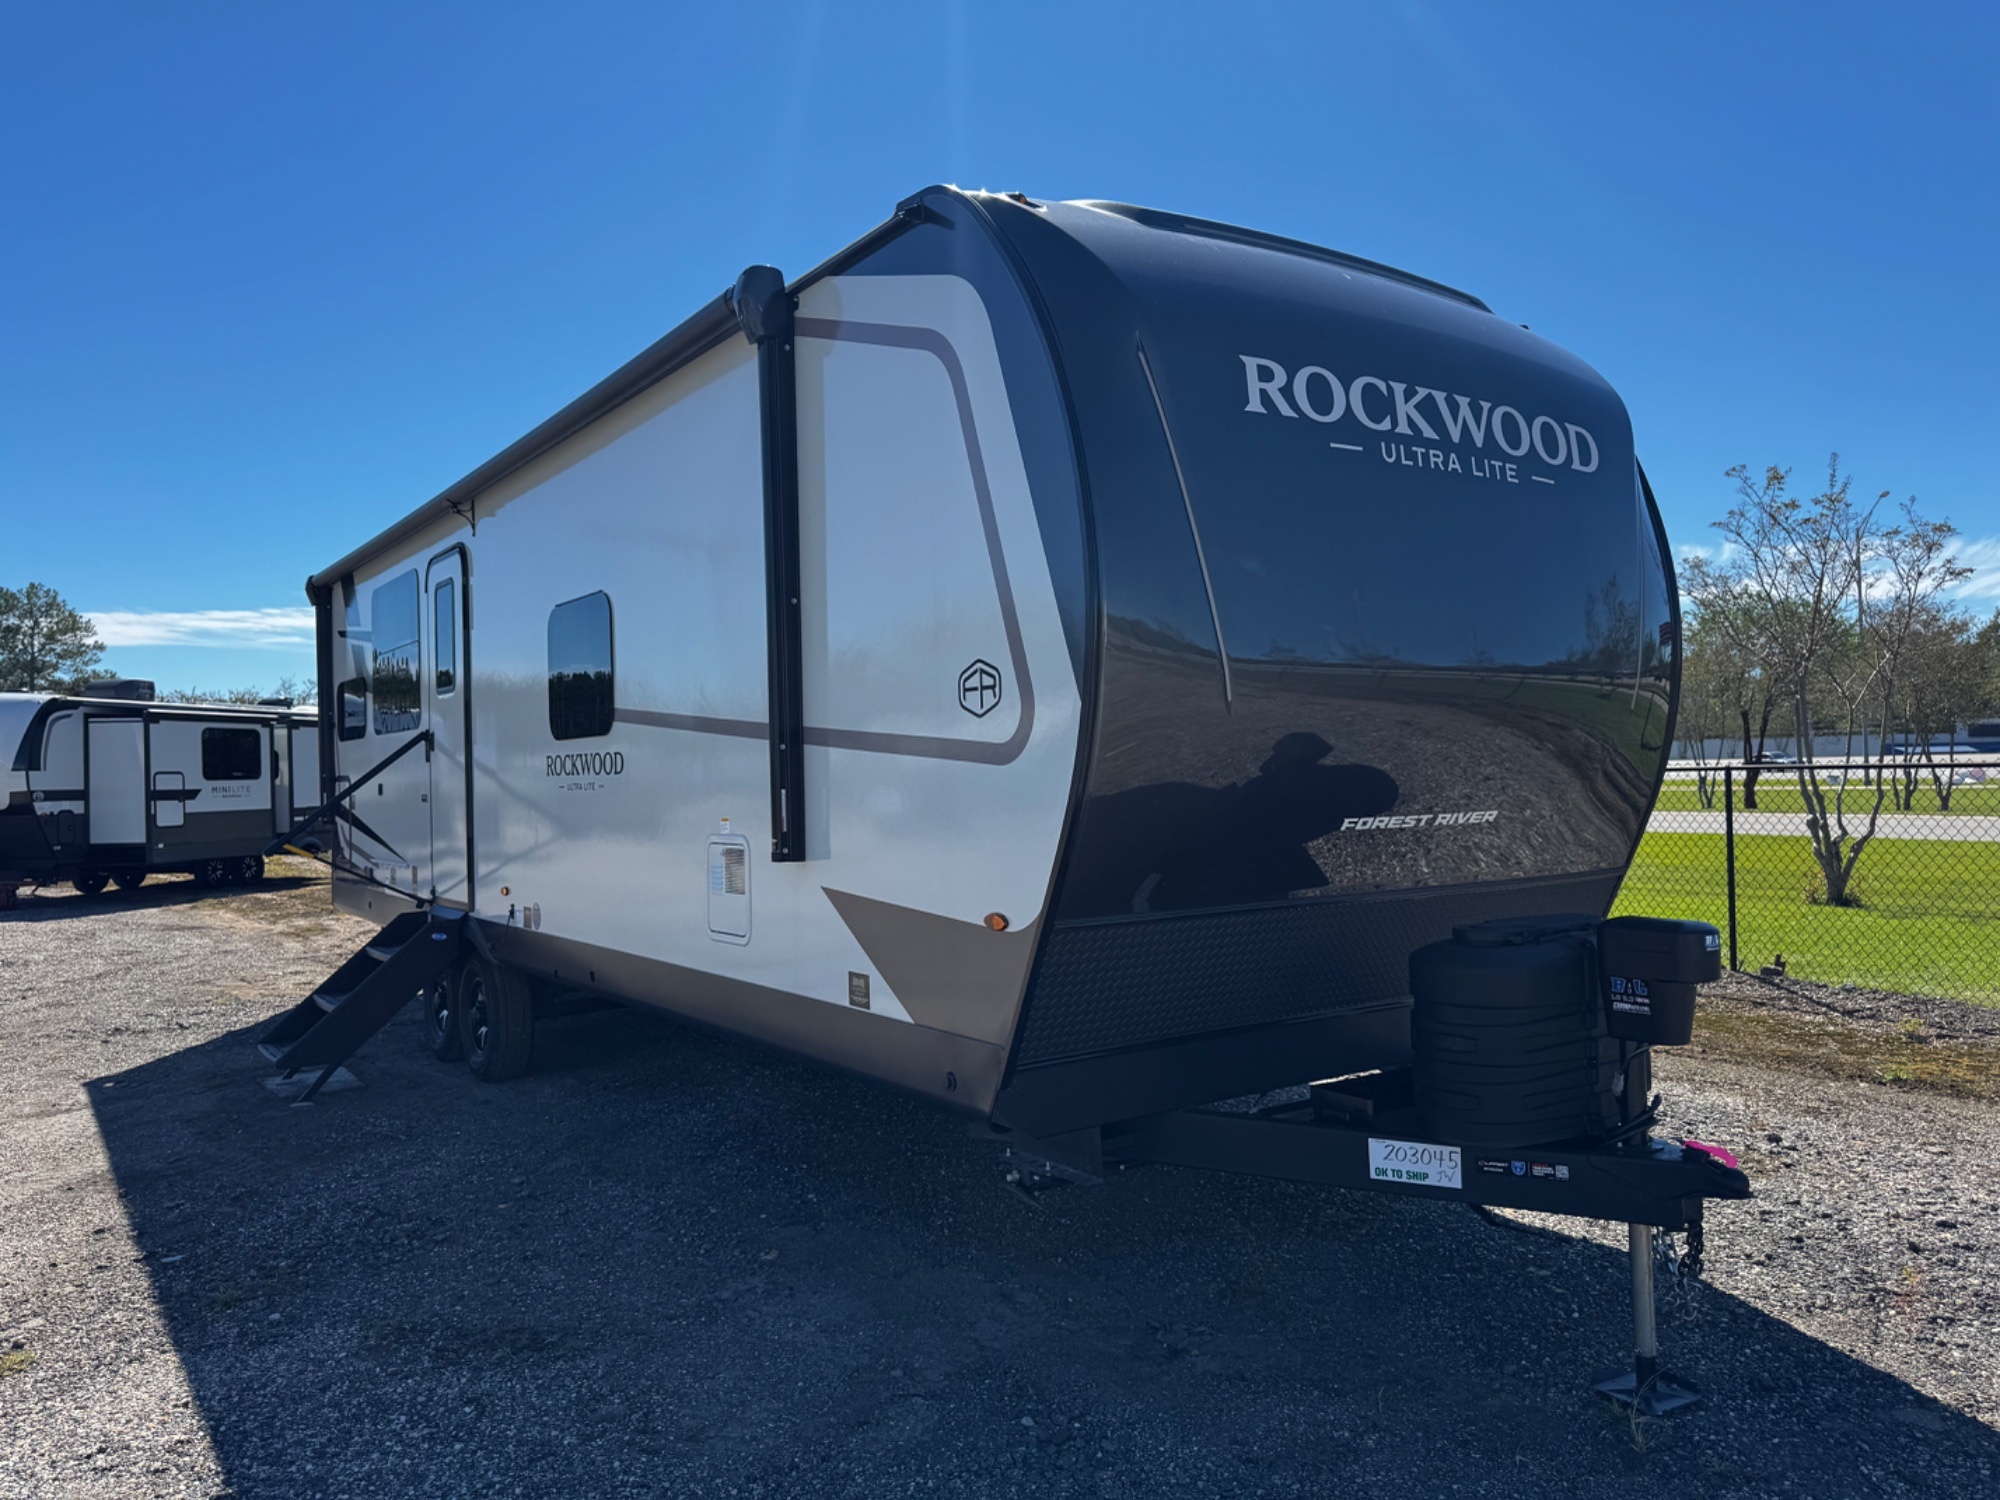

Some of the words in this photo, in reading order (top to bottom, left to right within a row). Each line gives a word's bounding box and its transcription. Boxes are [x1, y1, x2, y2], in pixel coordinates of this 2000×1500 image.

[1238, 354, 1600, 473] ROCKWOOD
[1380, 441, 1463, 474] ULTRA
[1471, 456, 1520, 484] LITE
[545, 751, 625, 777] ROCKWOOD
[1339, 813, 1434, 832] FOREST
[1433, 810, 1499, 827] RIVER
[1383, 1143, 1460, 1170] 203045
[1374, 1166, 1389, 1177] OK
[1390, 1167, 1403, 1180] TO
[1405, 1169, 1430, 1182] SHIP
